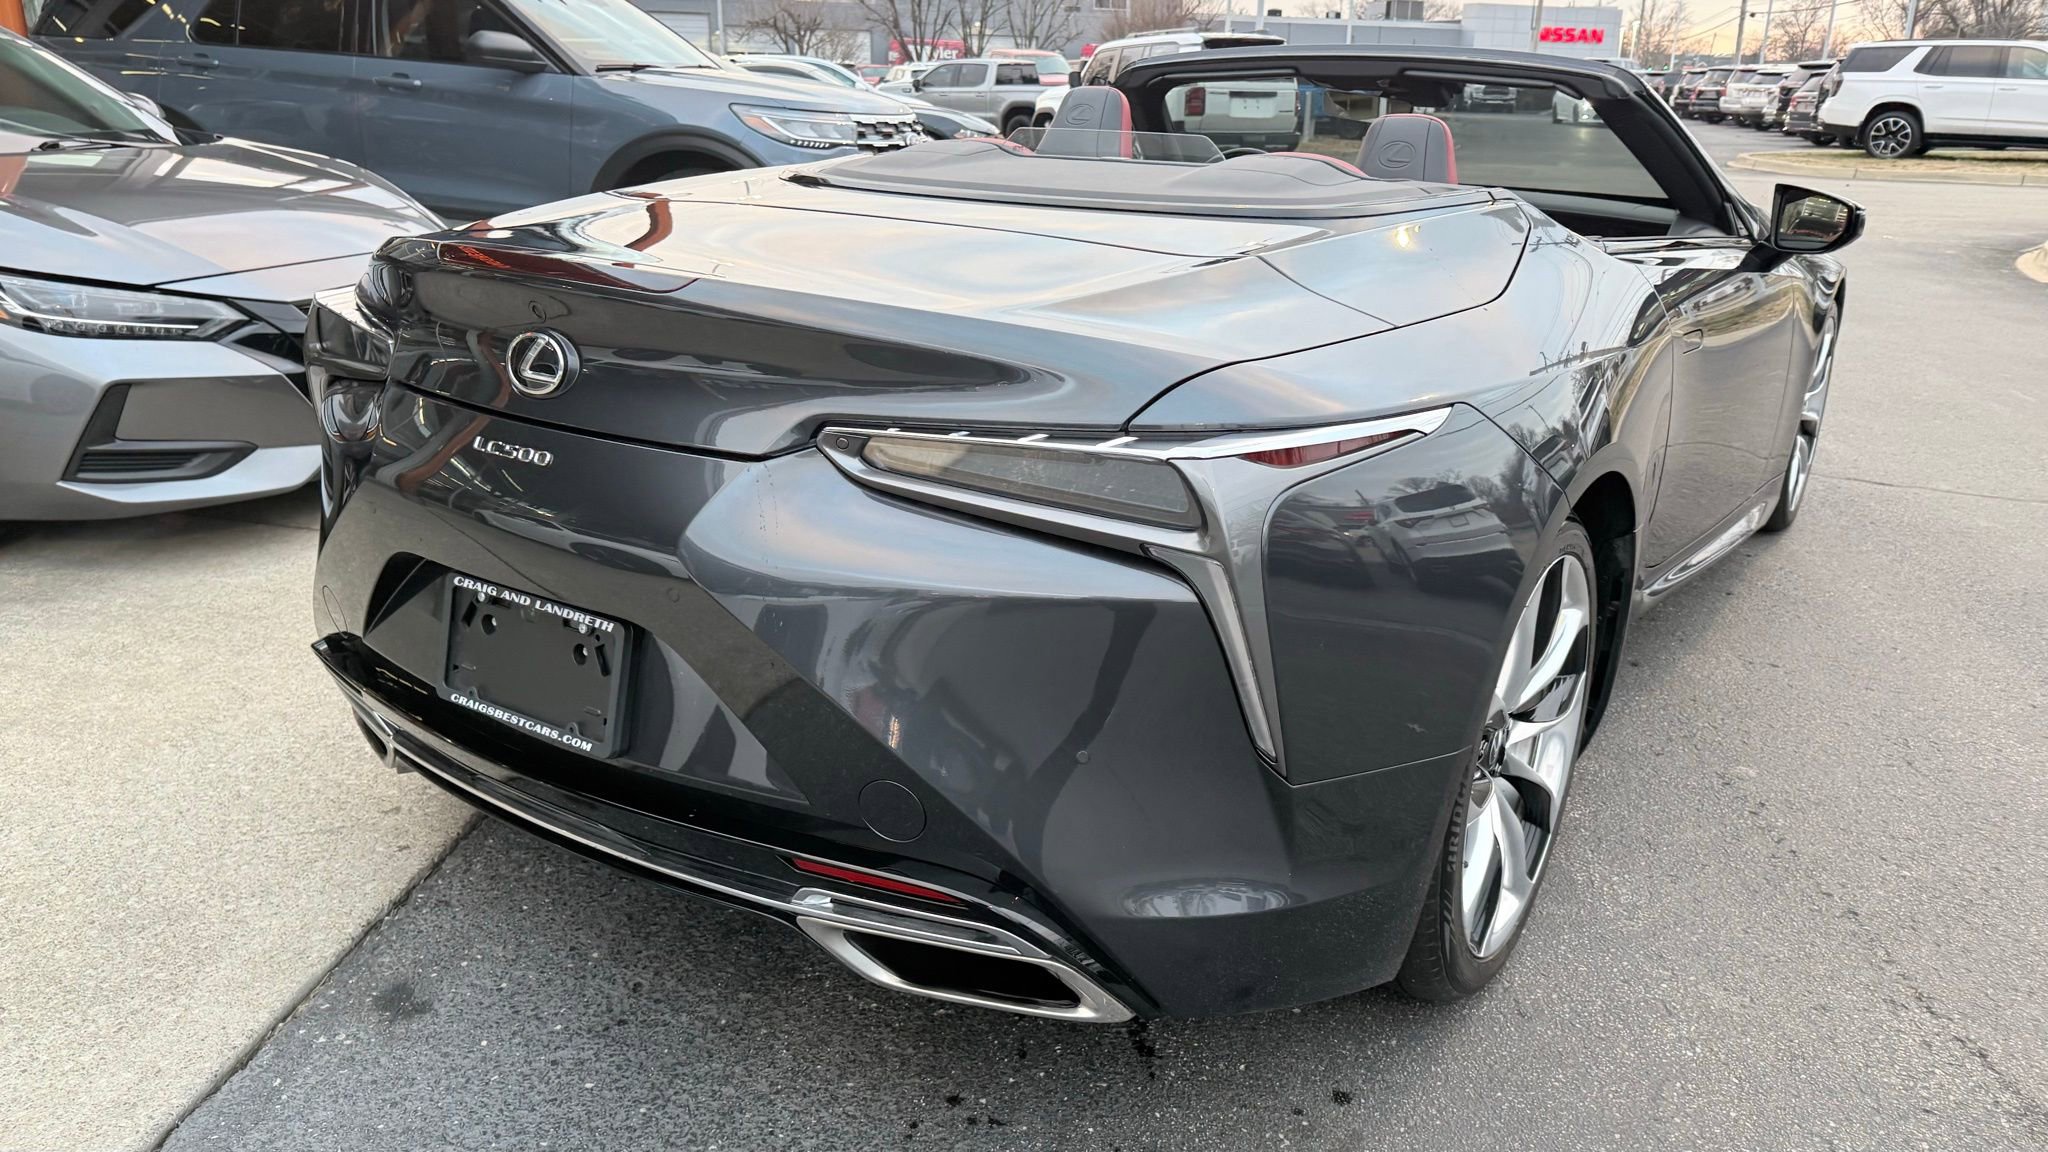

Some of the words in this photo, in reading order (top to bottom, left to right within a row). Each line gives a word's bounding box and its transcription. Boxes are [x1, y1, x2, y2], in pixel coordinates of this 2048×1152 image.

[473, 436, 554, 467] LC500
[453, 576, 498, 597] CRAIG
[501, 590, 531, 606] AND
[535, 599, 615, 633] LANDRETH
[450, 693, 593, 752] CRAIGSBESTCARS.COM
